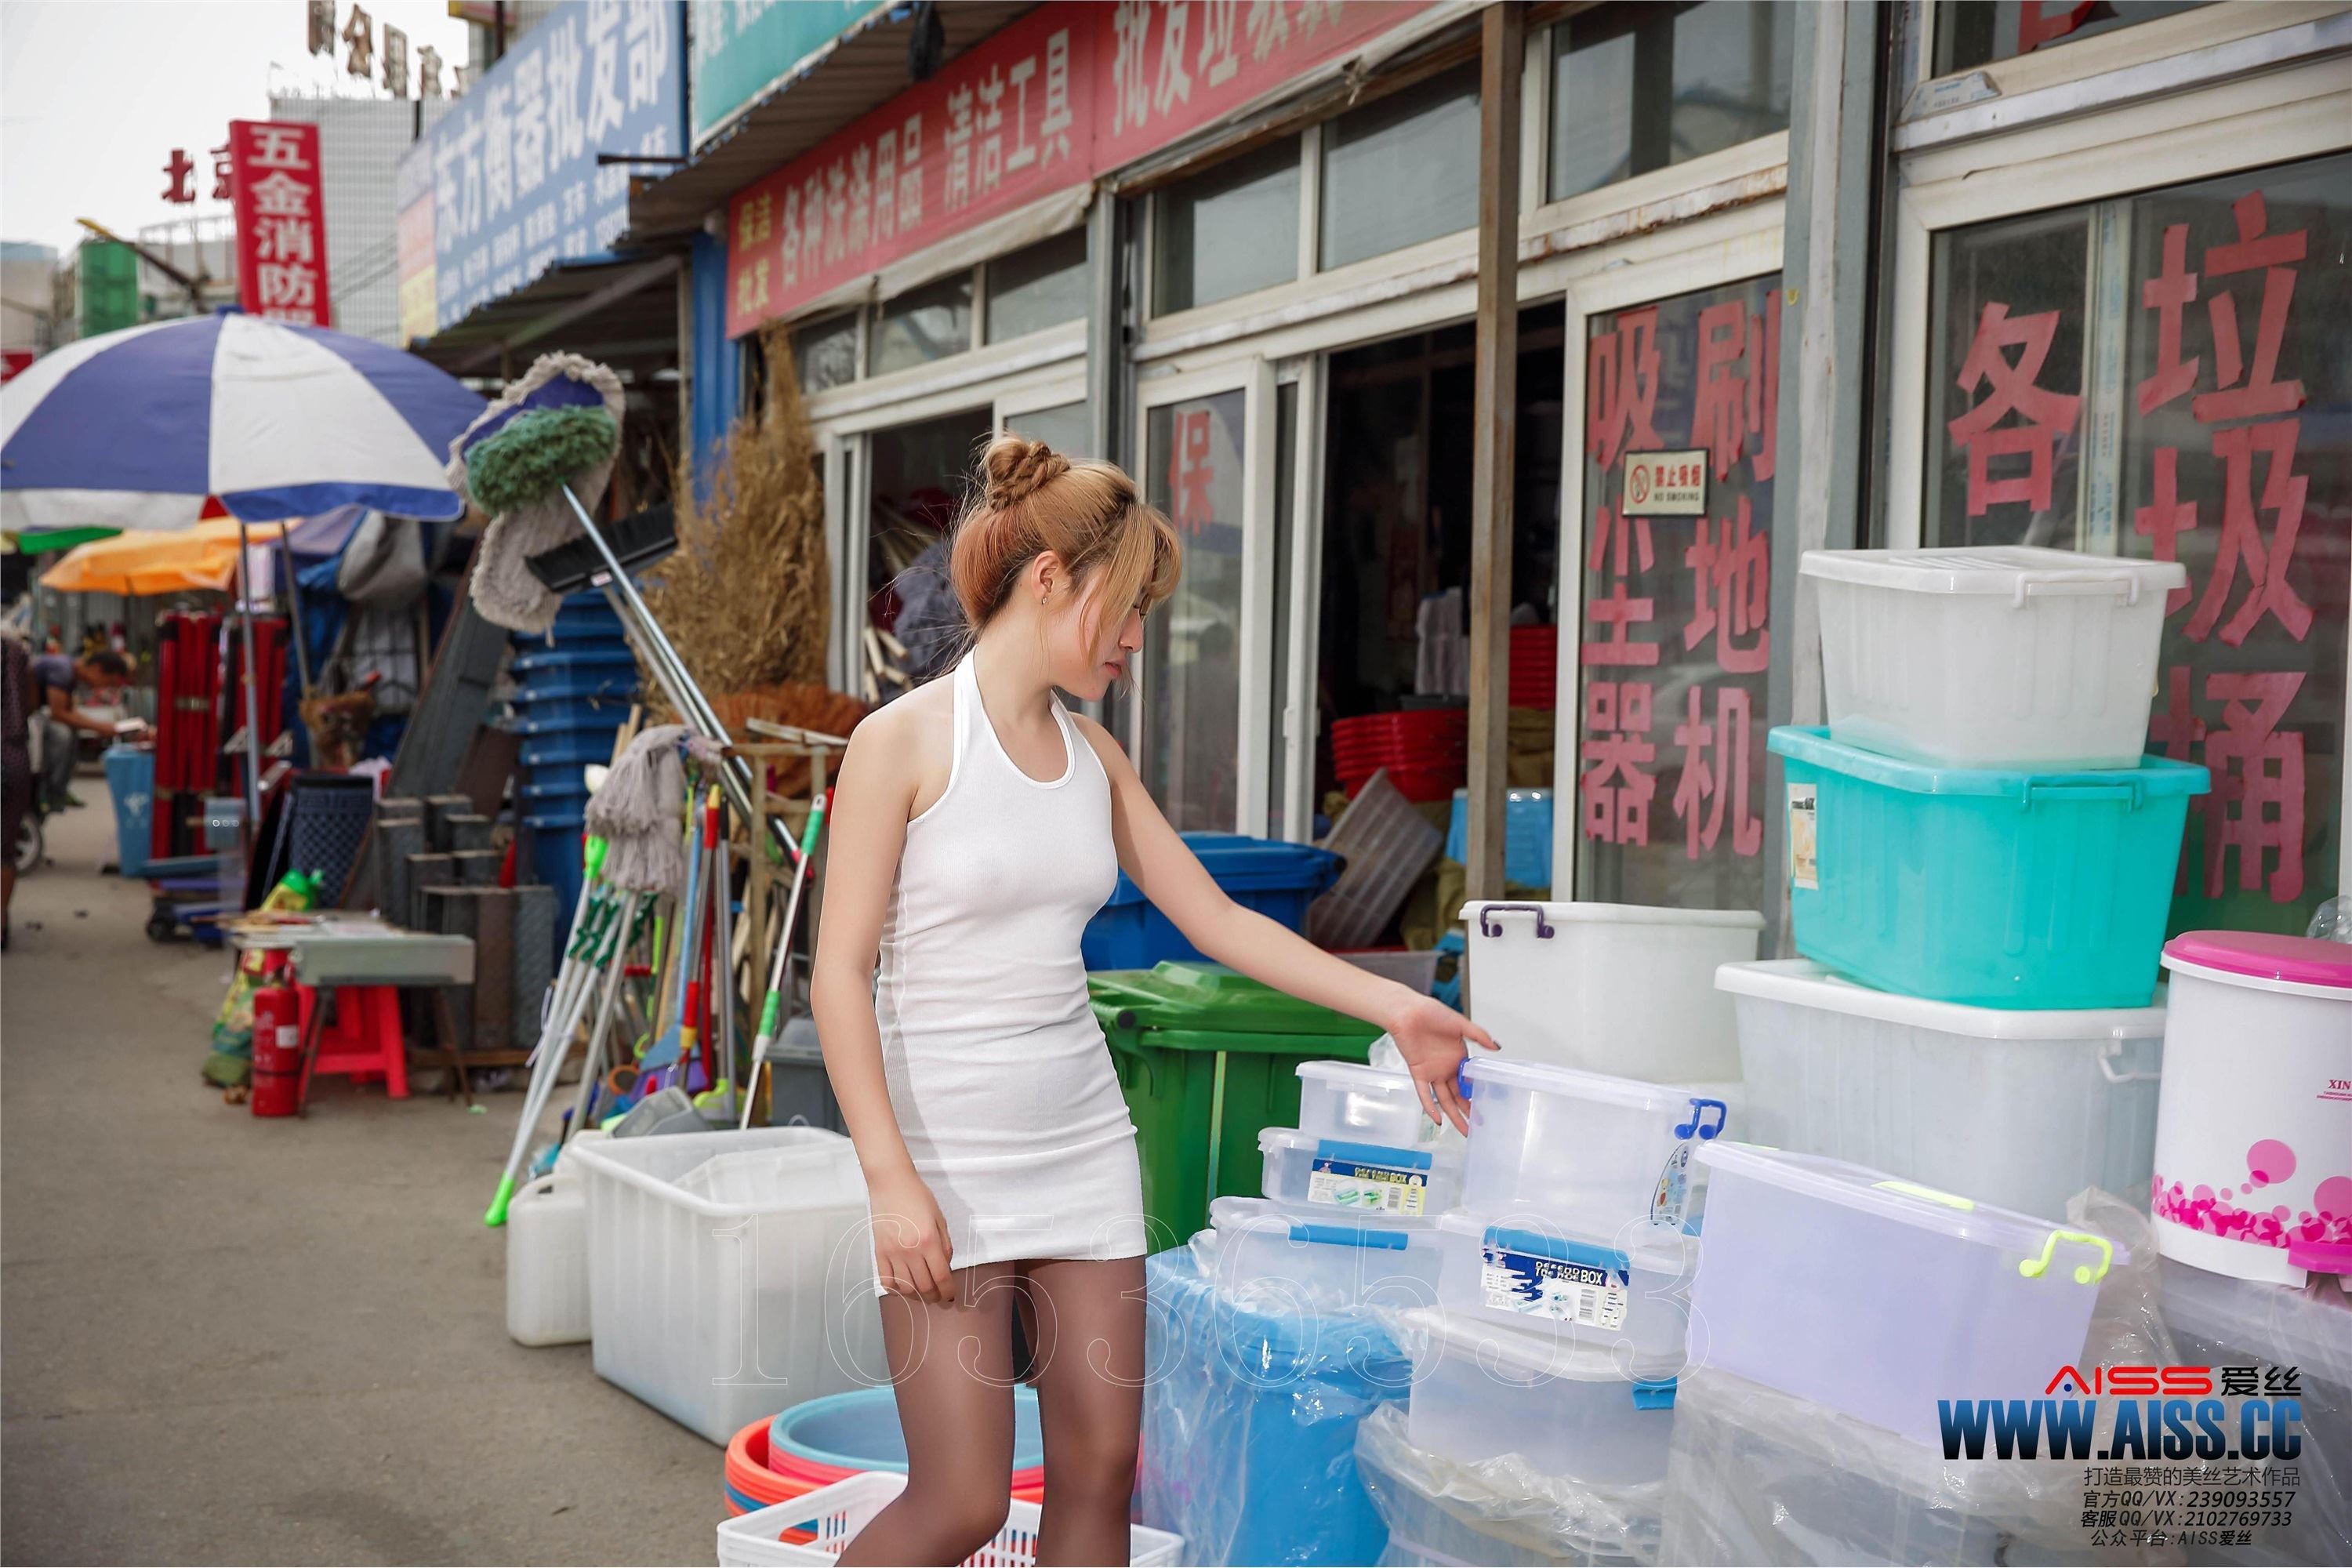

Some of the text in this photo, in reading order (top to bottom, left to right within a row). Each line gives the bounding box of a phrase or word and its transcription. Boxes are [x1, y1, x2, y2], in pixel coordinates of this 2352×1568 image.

[781, 112, 924, 292] 各种洗涤用品
[944, 27, 1073, 213] 清洁工具
[248, 125, 318, 326] 五金消防
[737, 257, 770, 315] 批发
[1947, 301, 2081, 517] 各
[1581, 1269, 1603, 1286] BOX
